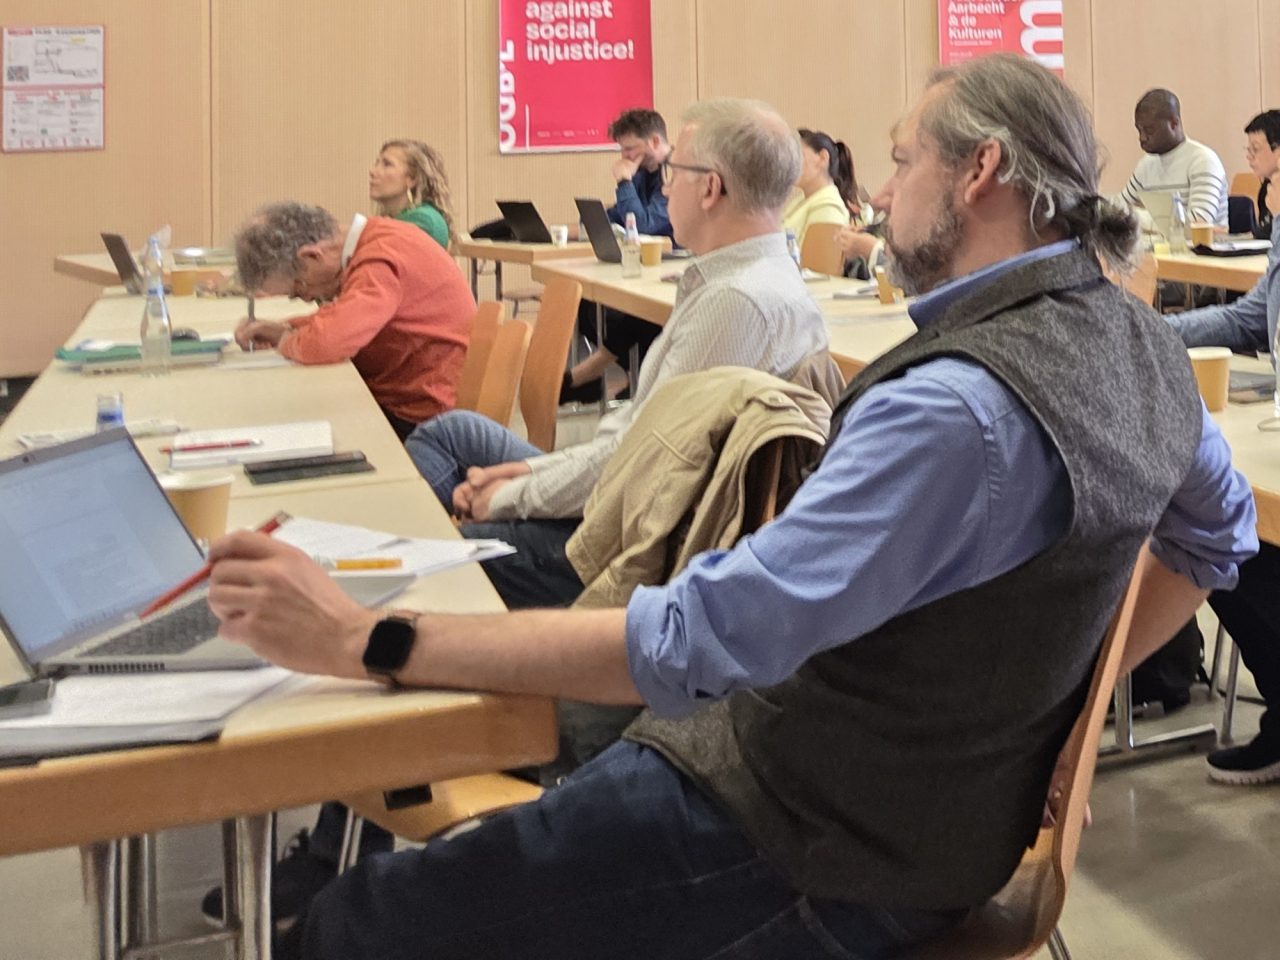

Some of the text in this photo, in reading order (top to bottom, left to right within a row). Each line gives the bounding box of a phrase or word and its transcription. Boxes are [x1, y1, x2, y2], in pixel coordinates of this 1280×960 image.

[948, 1, 1005, 15] Aarbecht
[961, 14, 977, 26] de
[526, 19, 597, 40] social
[949, 27, 1002, 38] Kulturen
[526, 40, 634, 64] injustice!
